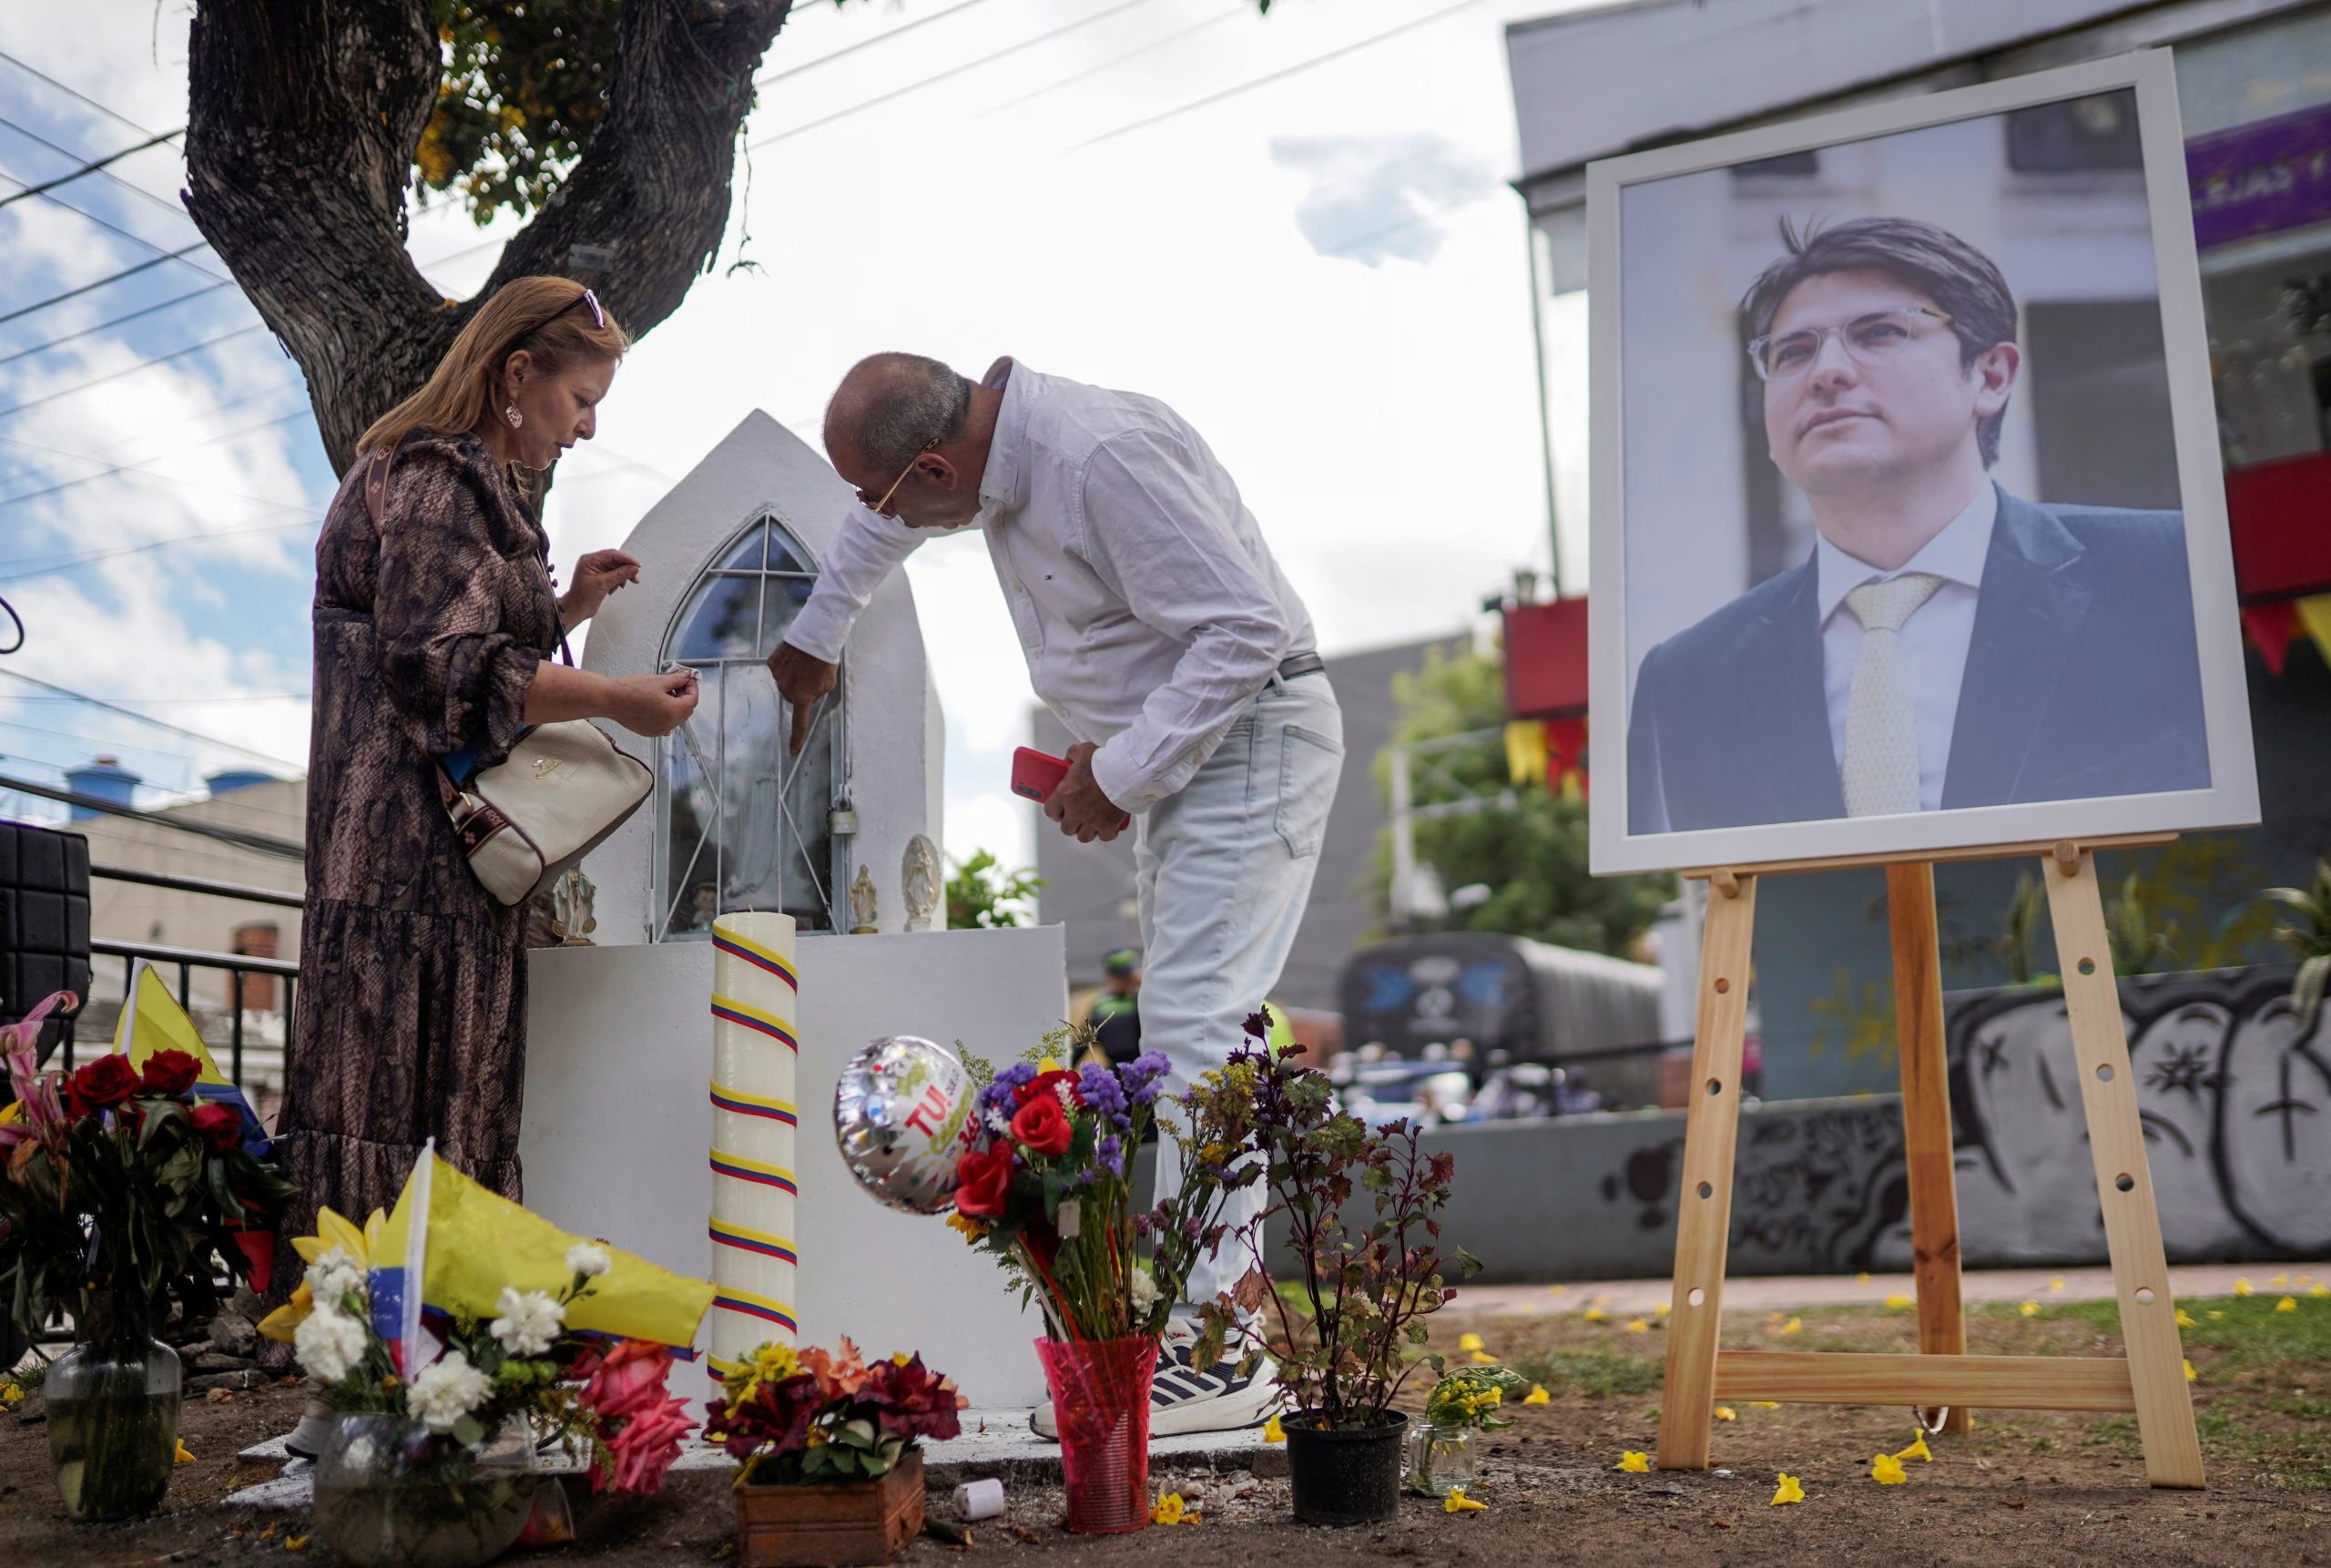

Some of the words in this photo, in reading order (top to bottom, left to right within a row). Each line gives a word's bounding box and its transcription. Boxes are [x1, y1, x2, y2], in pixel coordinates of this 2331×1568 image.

[945, 1077, 958, 1096] QUE
[903, 1084, 953, 1138] TU!
[957, 1108, 982, 1154] 365
